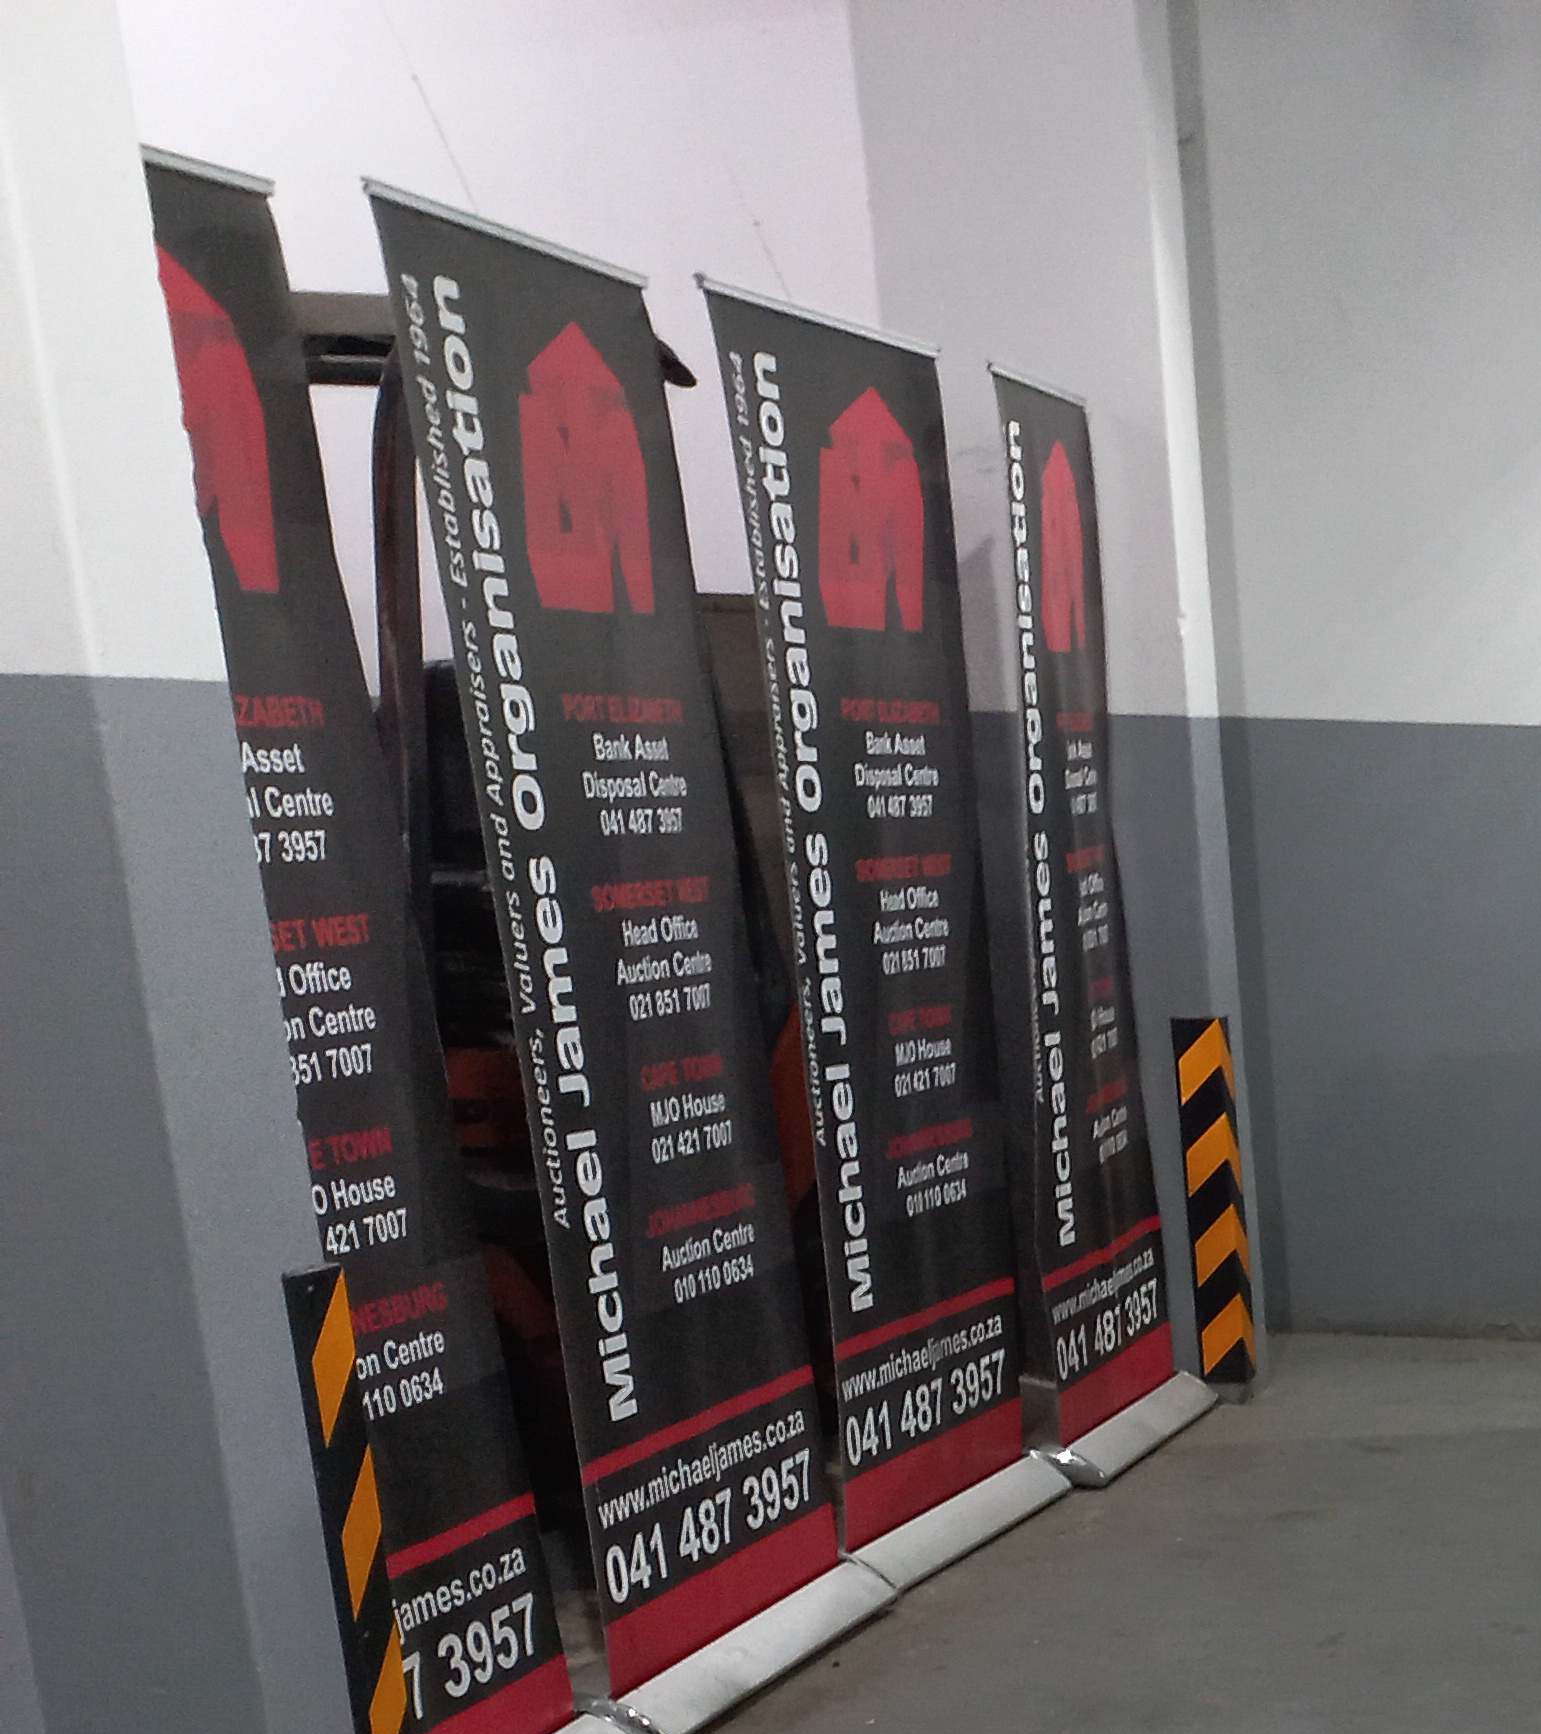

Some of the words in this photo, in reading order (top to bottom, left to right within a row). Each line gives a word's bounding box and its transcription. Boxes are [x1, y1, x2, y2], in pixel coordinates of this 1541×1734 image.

[401, 273, 431, 365] 1964
[417, 375, 468, 587] Established
[433, 275, 545, 831] Organisation
[753, 351, 822, 812] Organisation
[1006, 420, 1044, 816] Organisation
[461, 620, 505, 806] Appraisers
[240, 742, 305, 774] Asset
[593, 733, 633, 761] Bank
[264, 786, 335, 818] Centre
[582, 771, 647, 804] Disposal
[278, 830, 327, 862] 3957
[490, 813, 516, 882] and
[600, 809, 625, 836] 041
[628, 808, 653, 834] 487
[312, 913, 368, 948] WEST
[621, 916, 658, 947] Head
[660, 914, 699, 942] Office
[805, 832, 847, 1046] James
[1033, 830, 1059, 1017] James
[506, 890, 537, 1014] Valuers
[616, 956, 671, 985] Auction
[289, 962, 352, 996] Office
[529, 855, 590, 1108] James
[629, 992, 653, 1021] 021
[656, 988, 681, 1016] 851
[309, 1003, 377, 1037] Centre
[326, 1044, 372, 1079] 7007
[529, 1028, 572, 1230] Auctioneers,
[650, 1097, 681, 1128] MJO
[683, 1092, 726, 1121] House
[328, 1126, 393, 1165] TOWN
[652, 1136, 675, 1164] 021
[677, 1129, 701, 1156] 421
[703, 1120, 733, 1150] 7007
[1043, 1030, 1077, 1249] Michael
[332, 1175, 396, 1210] House
[825, 1063, 874, 1313] Michael
[325, 1219, 360, 1255] 421
[363, 1208, 407, 1245] 7007
[662, 1236, 711, 1272] Auction
[712, 1223, 755, 1254] Centre
[565, 1129, 639, 1423] Michael
[675, 1276, 697, 1303] 010
[698, 1265, 721, 1294] 110
[723, 1253, 754, 1286] 0634
[383, 1328, 446, 1372] Centre
[1056, 1323, 1088, 1381] 041
[1125, 1277, 1157, 1336] 3957
[362, 1384, 397, 1421] 110
[399, 1367, 444, 1409] 0634
[846, 1400, 892, 1466] 041
[901, 1377, 943, 1438] 487
[950, 1348, 1005, 1415] 3957
[598, 1410, 805, 1529] www.michaeljames.co.za
[606, 1521, 668, 1603] 041
[679, 1487, 732, 1562] 487
[743, 1447, 810, 1530] 3957
[438, 1593, 535, 1699] 3957
